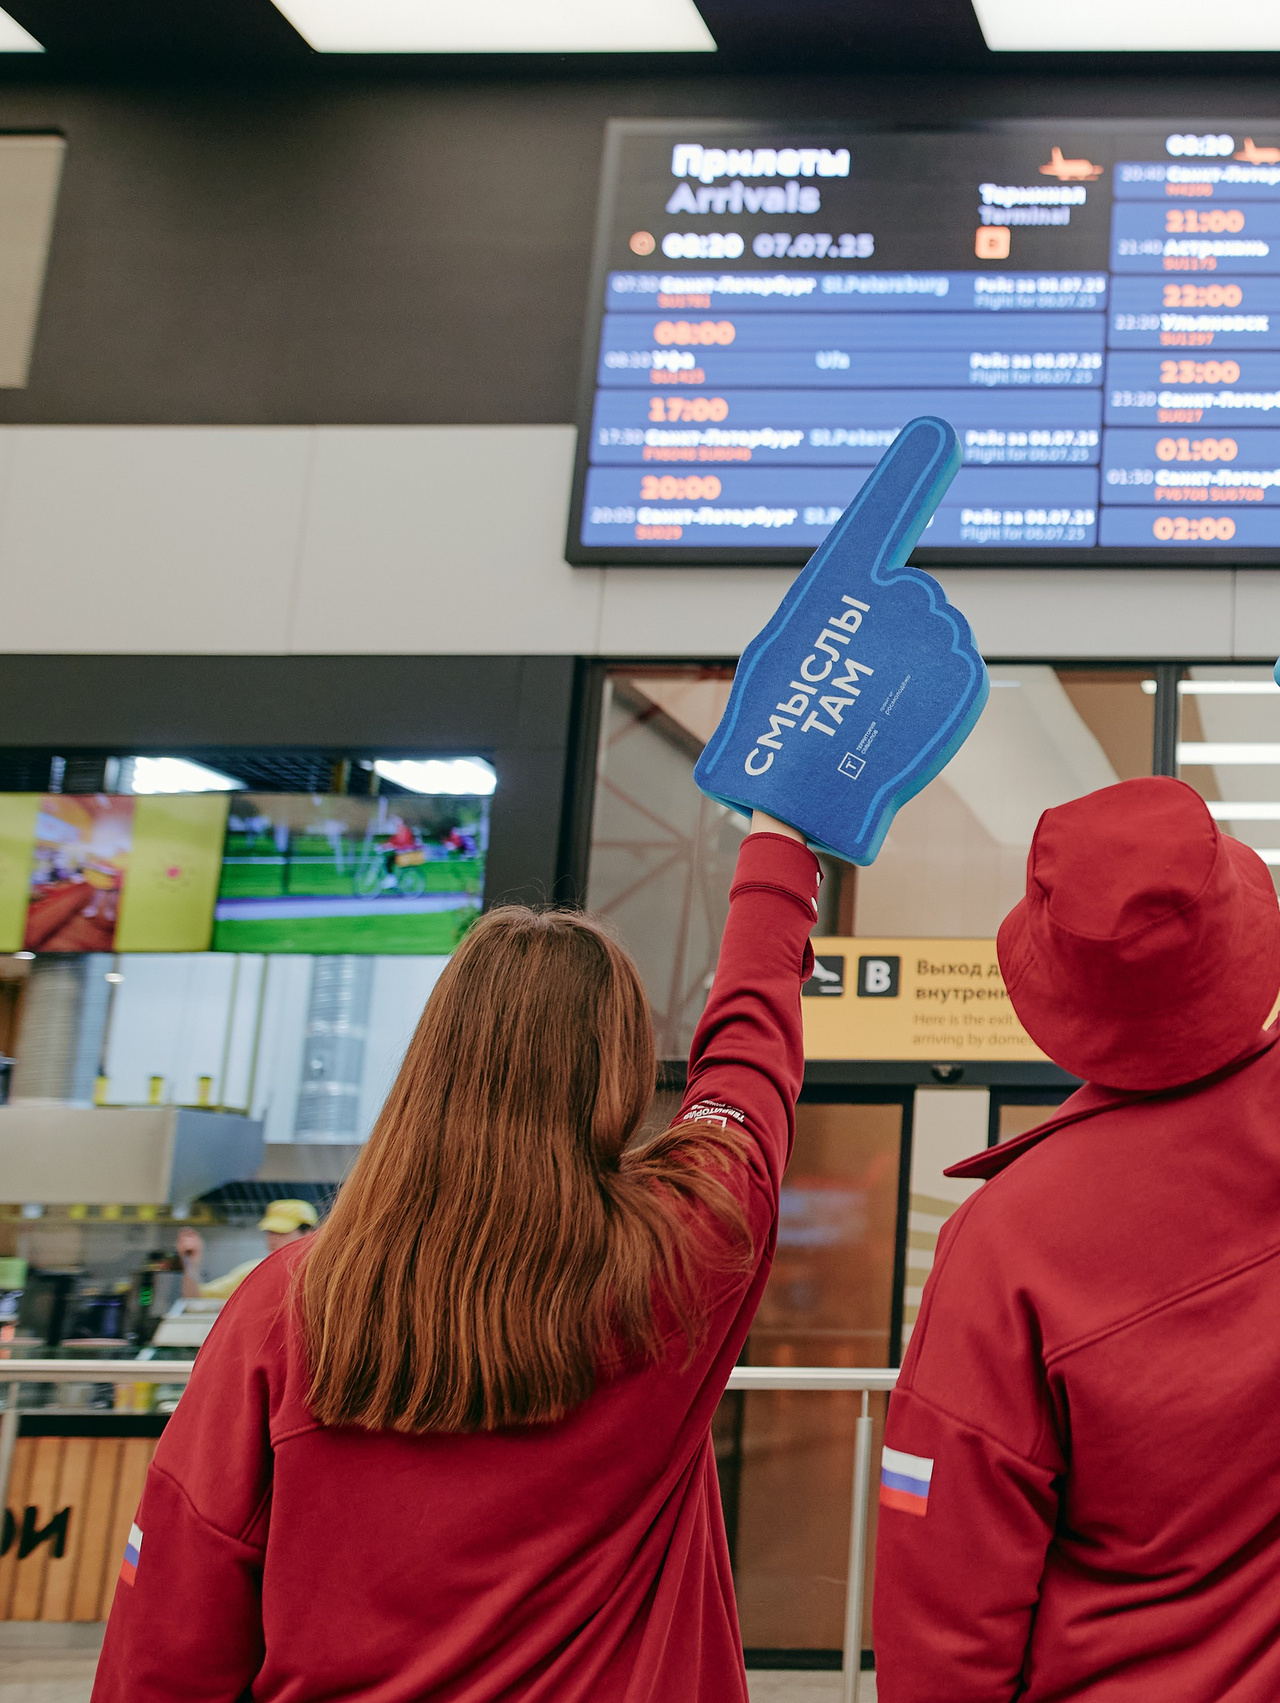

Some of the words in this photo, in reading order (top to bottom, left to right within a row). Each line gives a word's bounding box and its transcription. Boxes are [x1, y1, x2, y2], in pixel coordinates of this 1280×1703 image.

[671, 143, 850, 183] Прилеты
[665, 180, 821, 214] Arrivals
[1165, 210, 1245, 233] 21:00
[752, 233, 874, 258] 07.07.25
[1162, 284, 1243, 308] 22:00
[1159, 360, 1241, 384] 23:00
[648, 397, 729, 422] 17:00
[1155, 437, 1239, 462] 01:00
[1152, 515, 1236, 541] 02:00
[744, 594, 871, 777] СМЫСЛЫ
[801, 657, 875, 737] ТАМ
[856, 721, 877, 752] ТЕРРИТОРИЯ
[861, 729, 879, 755] СМЫСЛОВ
[917, 959, 982, 977] Выход
[914, 1013, 945, 1026] Here
[950, 1012, 959, 1025] is
[963, 1012, 986, 1025] the
[989, 1013, 1014, 1026] exit
[913, 1034, 964, 1049] arriving
[968, 1034, 984, 1049] by
